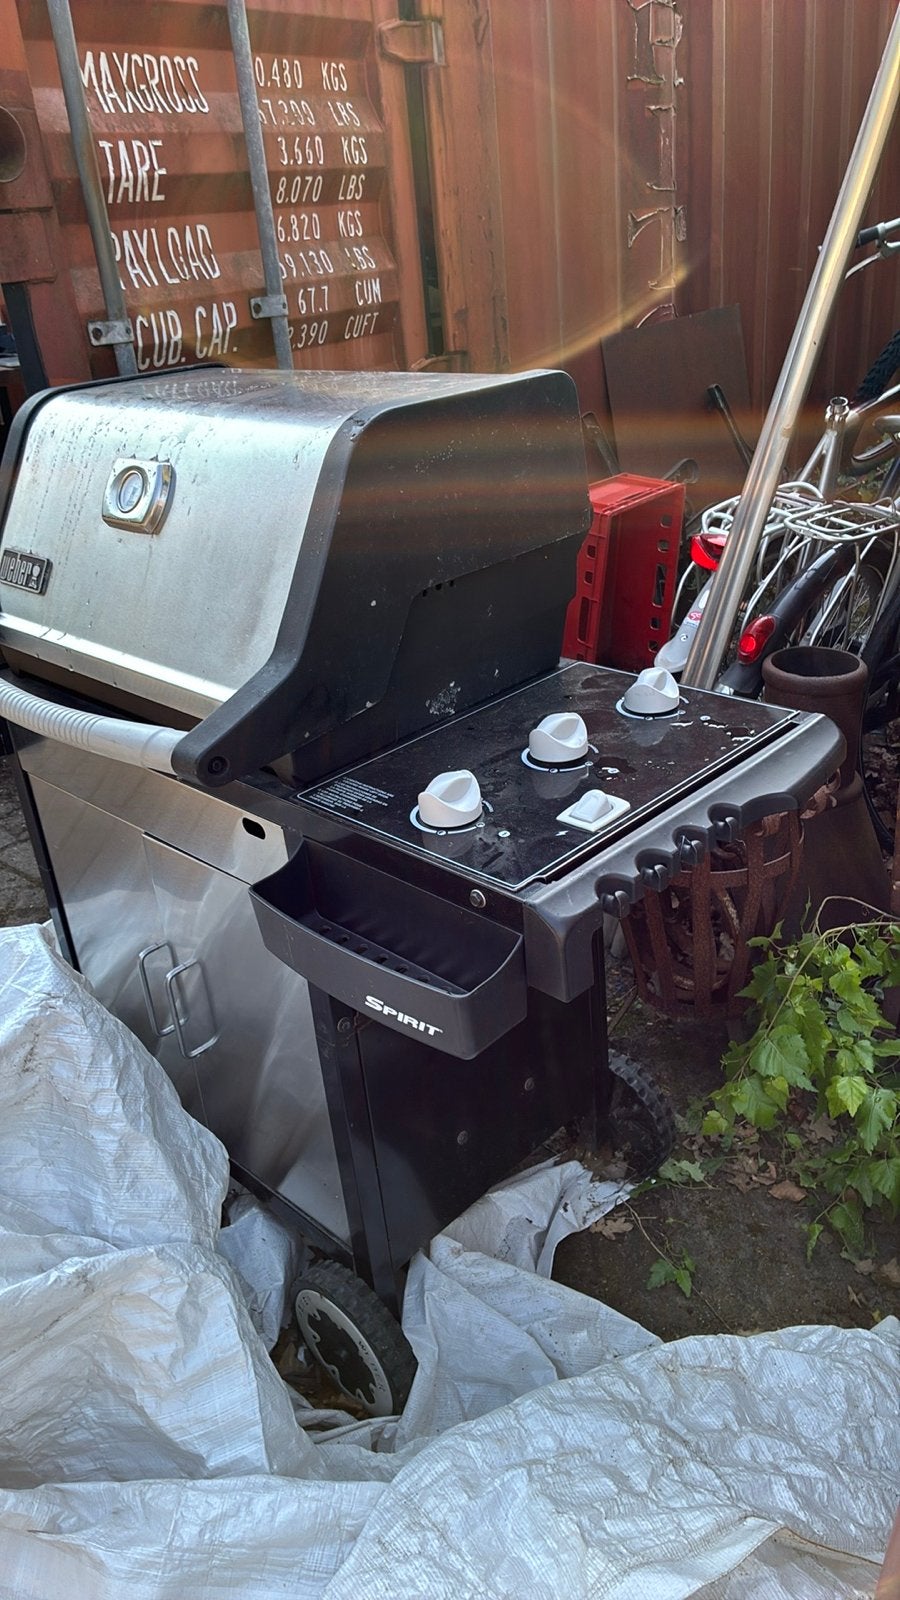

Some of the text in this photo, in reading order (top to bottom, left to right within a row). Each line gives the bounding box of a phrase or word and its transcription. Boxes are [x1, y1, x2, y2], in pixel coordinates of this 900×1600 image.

[80, 51, 209, 114] MAXGROSS
[321, 61, 348, 91] KGS
[328, 101, 360, 126] LBS
[277, 135, 368, 165] 3.660 KGS
[98, 140, 167, 204] TARE
[276, 174, 365, 204] 8.070 LBS
[277, 210, 363, 242] 6.820 KGS
[111, 224, 221, 290] PAYLOAD
[345, 245, 376, 271] LBS
[298, 278, 382, 314] 67.7 CUM
[136, 301, 238, 370] CUB. CAP.
[344, 312, 379, 339] CUFT
[365, 995, 443, 1036] SPIRIT
